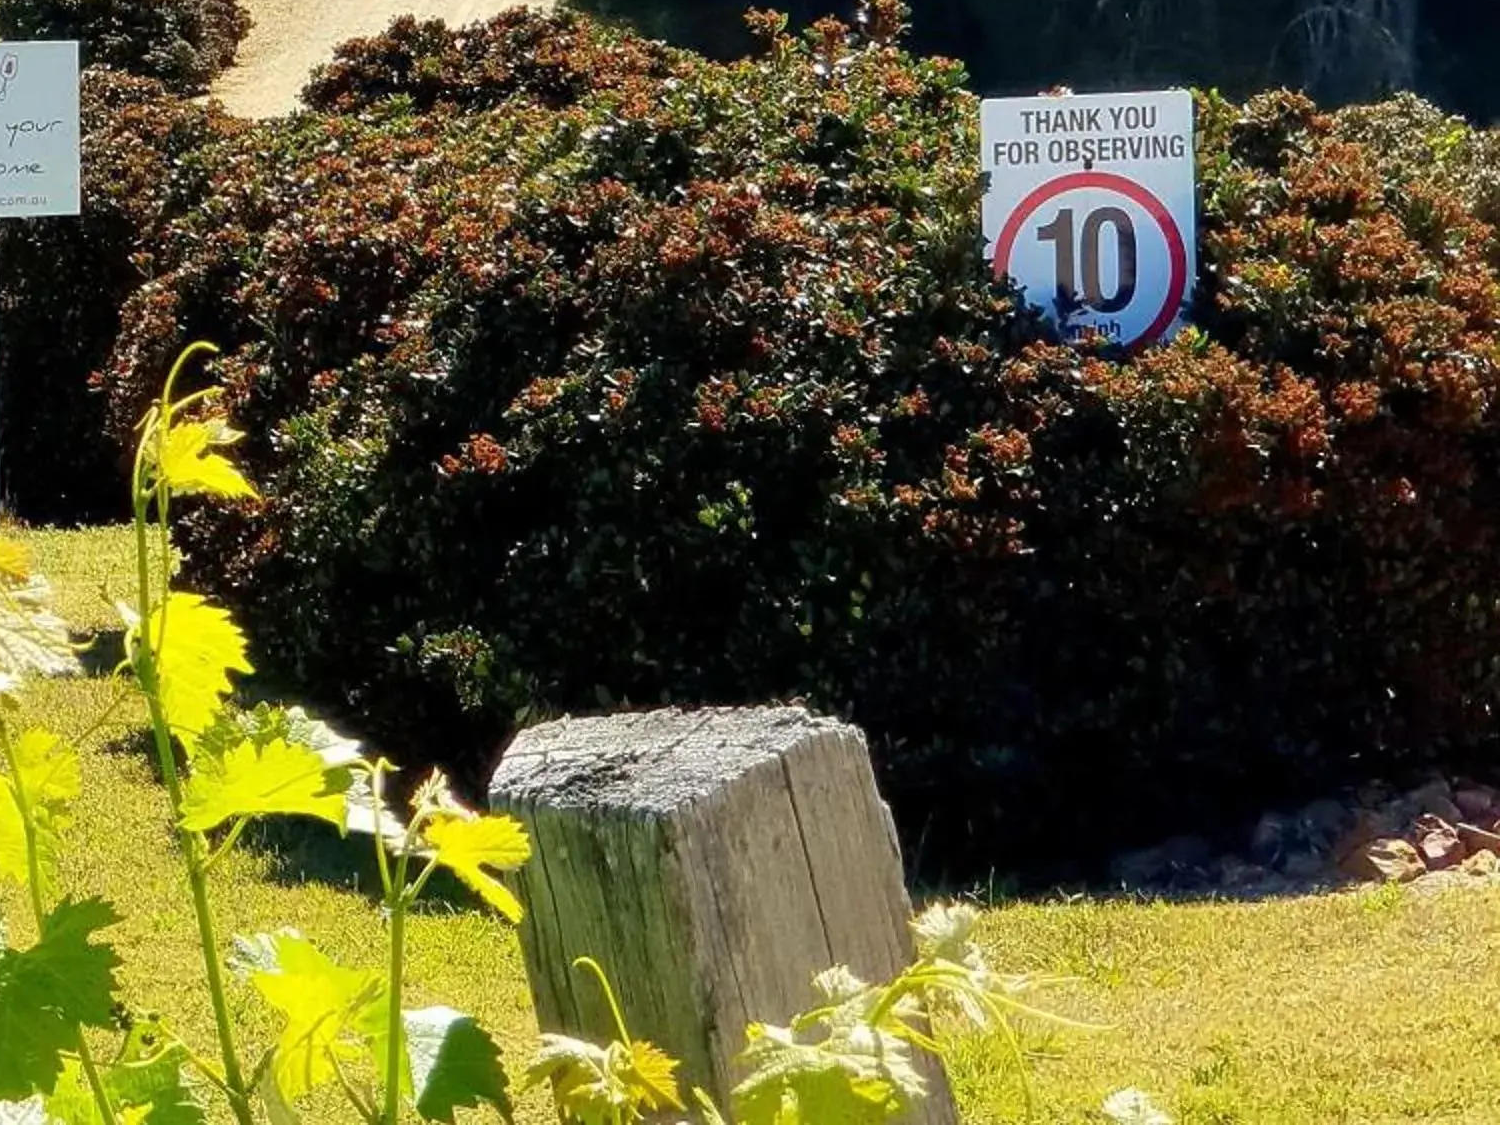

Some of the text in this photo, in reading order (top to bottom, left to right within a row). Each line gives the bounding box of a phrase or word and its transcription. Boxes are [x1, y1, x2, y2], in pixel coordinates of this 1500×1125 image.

[5, 118, 63, 147] your
[1020, 105, 1157, 134] THANK YOU
[993, 134, 1185, 166] FOR OBSERVING
[1037, 206, 1137, 314] 10
